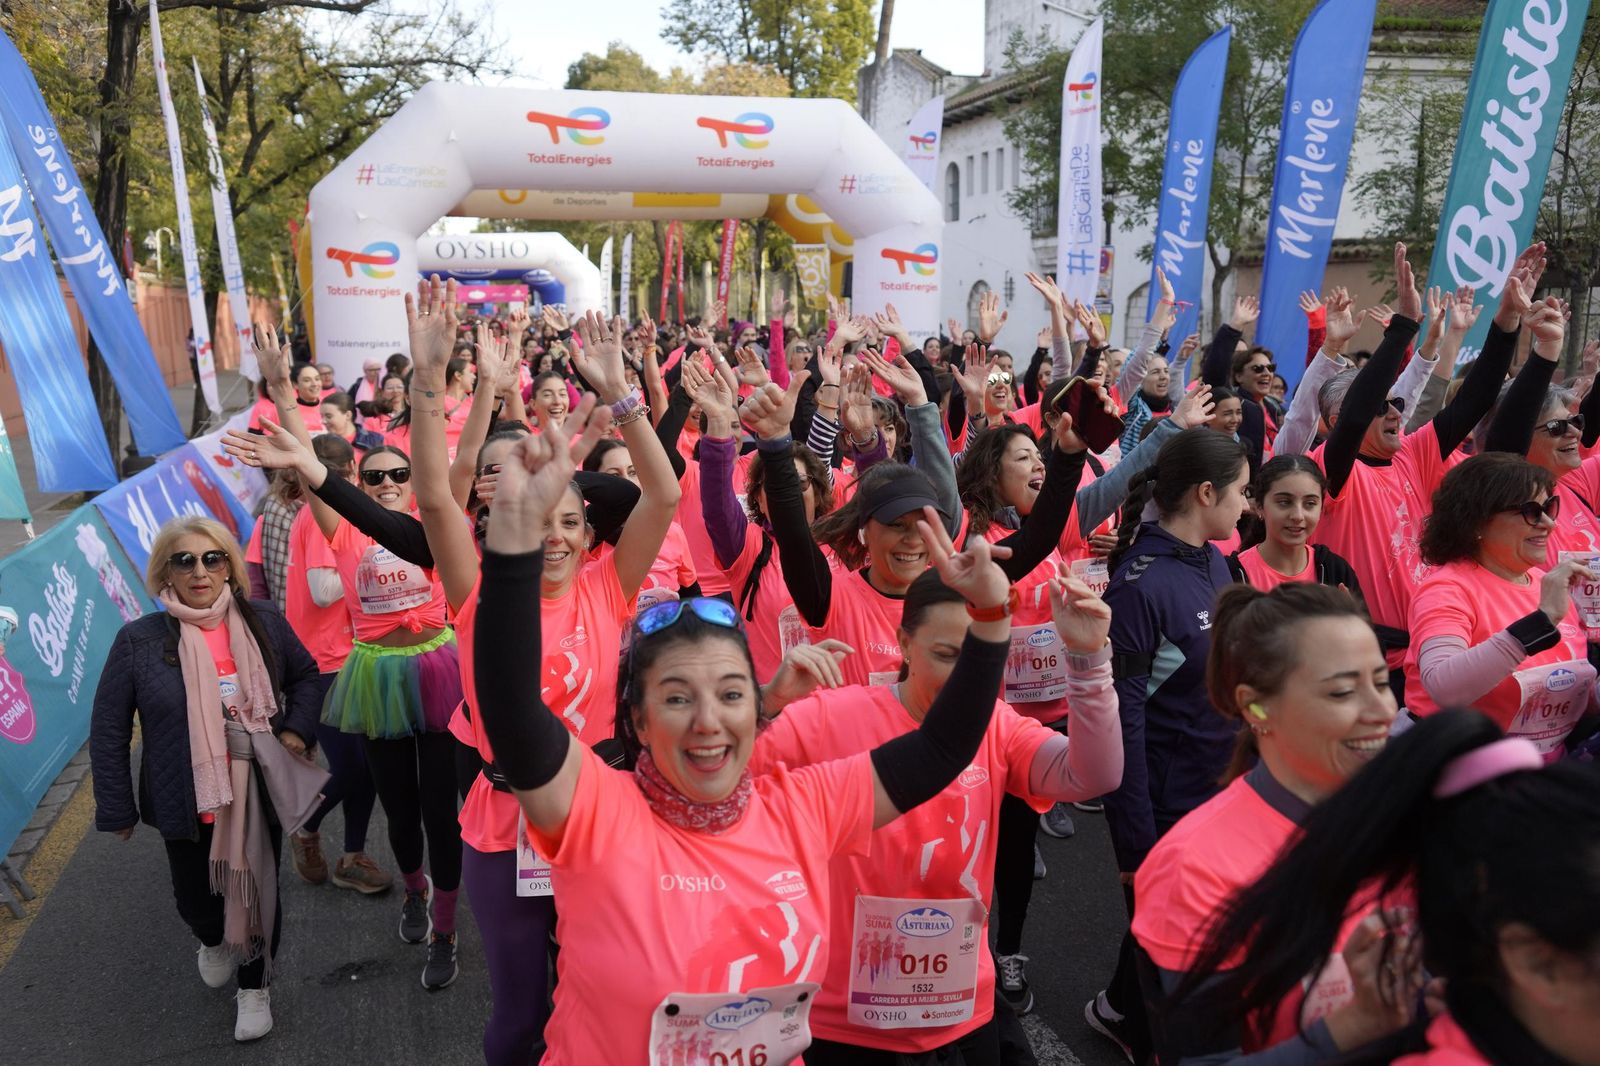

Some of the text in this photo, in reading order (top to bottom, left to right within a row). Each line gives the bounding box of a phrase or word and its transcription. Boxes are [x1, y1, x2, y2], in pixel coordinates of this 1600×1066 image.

[1447, 0, 1567, 299] Batiste
[527, 153, 613, 167] TotalEnergies
[696, 156, 775, 170] TotalEnergies
[1276, 98, 1341, 259] Marlene
[1160, 139, 1204, 276] Marlene
[436, 240, 529, 260] OYSHO
[327, 285, 401, 298] TotalEnergies
[378, 570, 408, 585] 016
[1032, 655, 1057, 670] 016
[1014, 691, 1042, 699] OYSHO
[0, 699, 28, 729] ESPAÑA
[1541, 701, 1571, 718] 016
[660, 874, 726, 893] OYSHO
[865, 919, 893, 929] SUMA
[901, 918, 950, 931] ASTURIANA
[900, 953, 949, 975] 016
[911, 983, 934, 993] 1532
[870, 996, 899, 1004] CARRERA
[901, 996, 909, 1004] DE
[864, 1010, 907, 1022] OYSHO
[931, 1008, 965, 1020] Santander
[666, 1017, 700, 1028] SUMA
